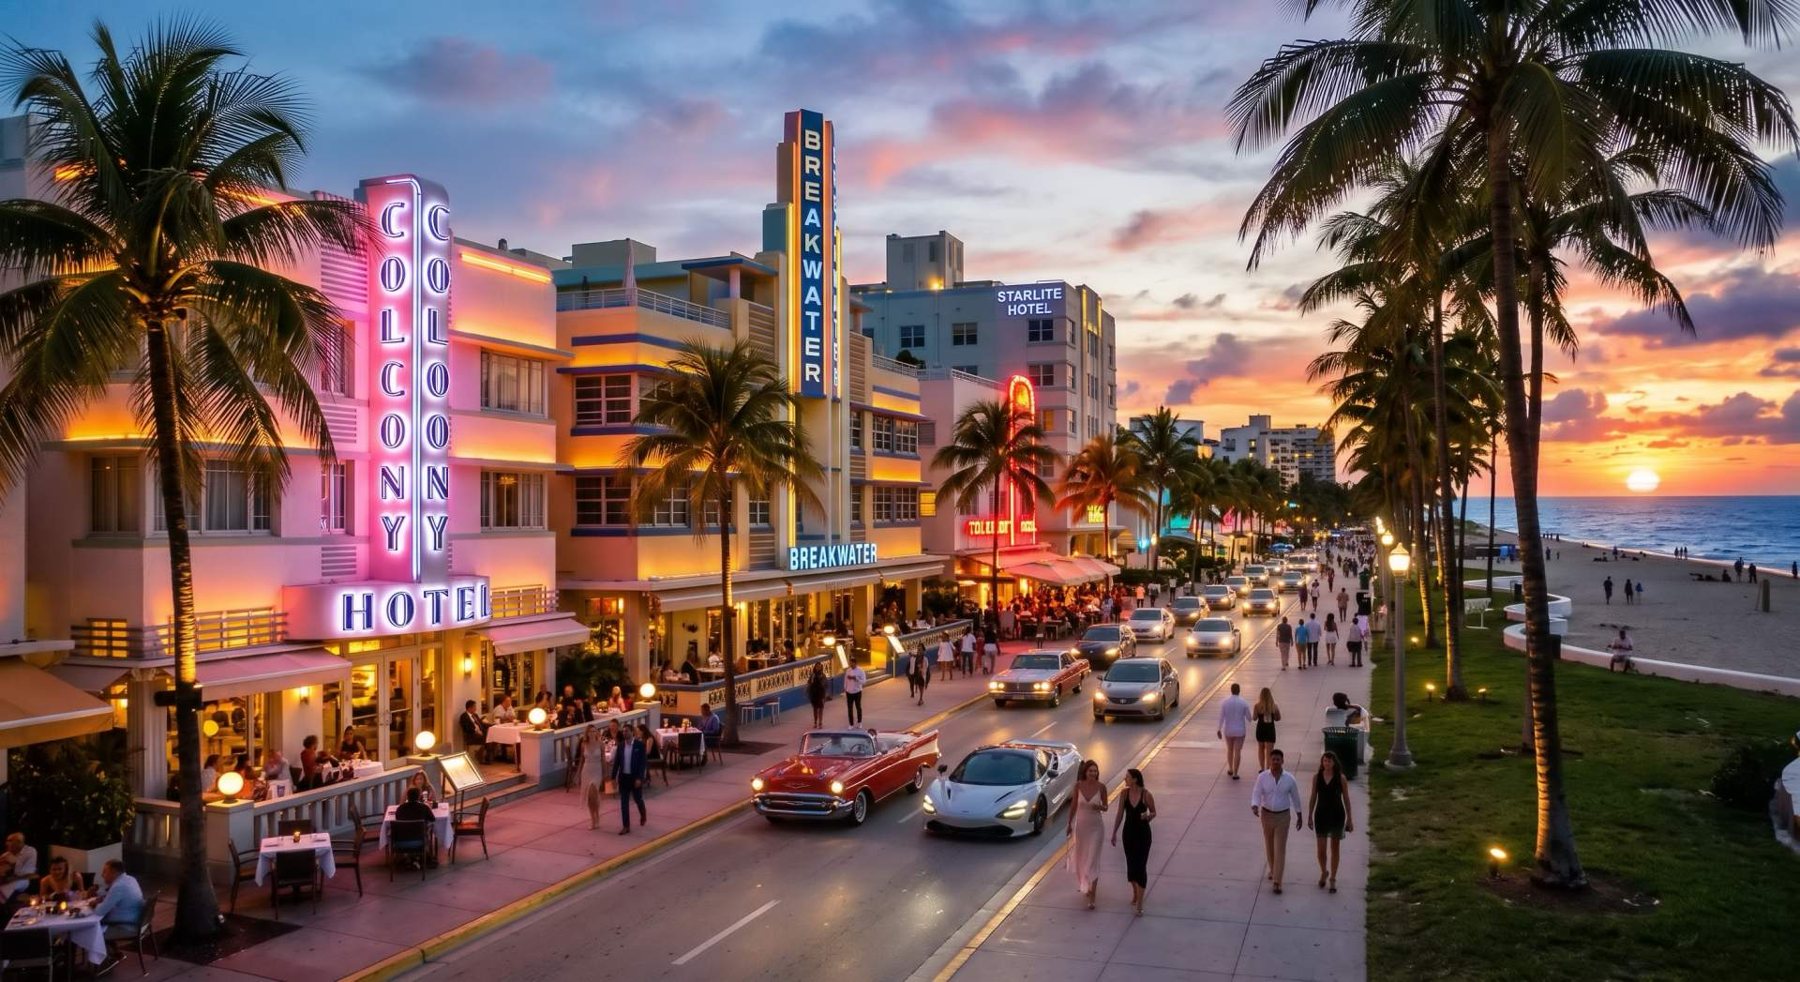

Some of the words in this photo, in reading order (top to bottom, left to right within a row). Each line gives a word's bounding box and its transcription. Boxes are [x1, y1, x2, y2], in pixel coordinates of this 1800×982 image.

[803, 130, 823, 383] BREAKWATER
[997, 288, 1062, 302] STARLITE
[1008, 303, 1052, 316] HOTEL
[790, 543, 877, 570] BREAKWATER
[343, 584, 491, 631] HOTEL
